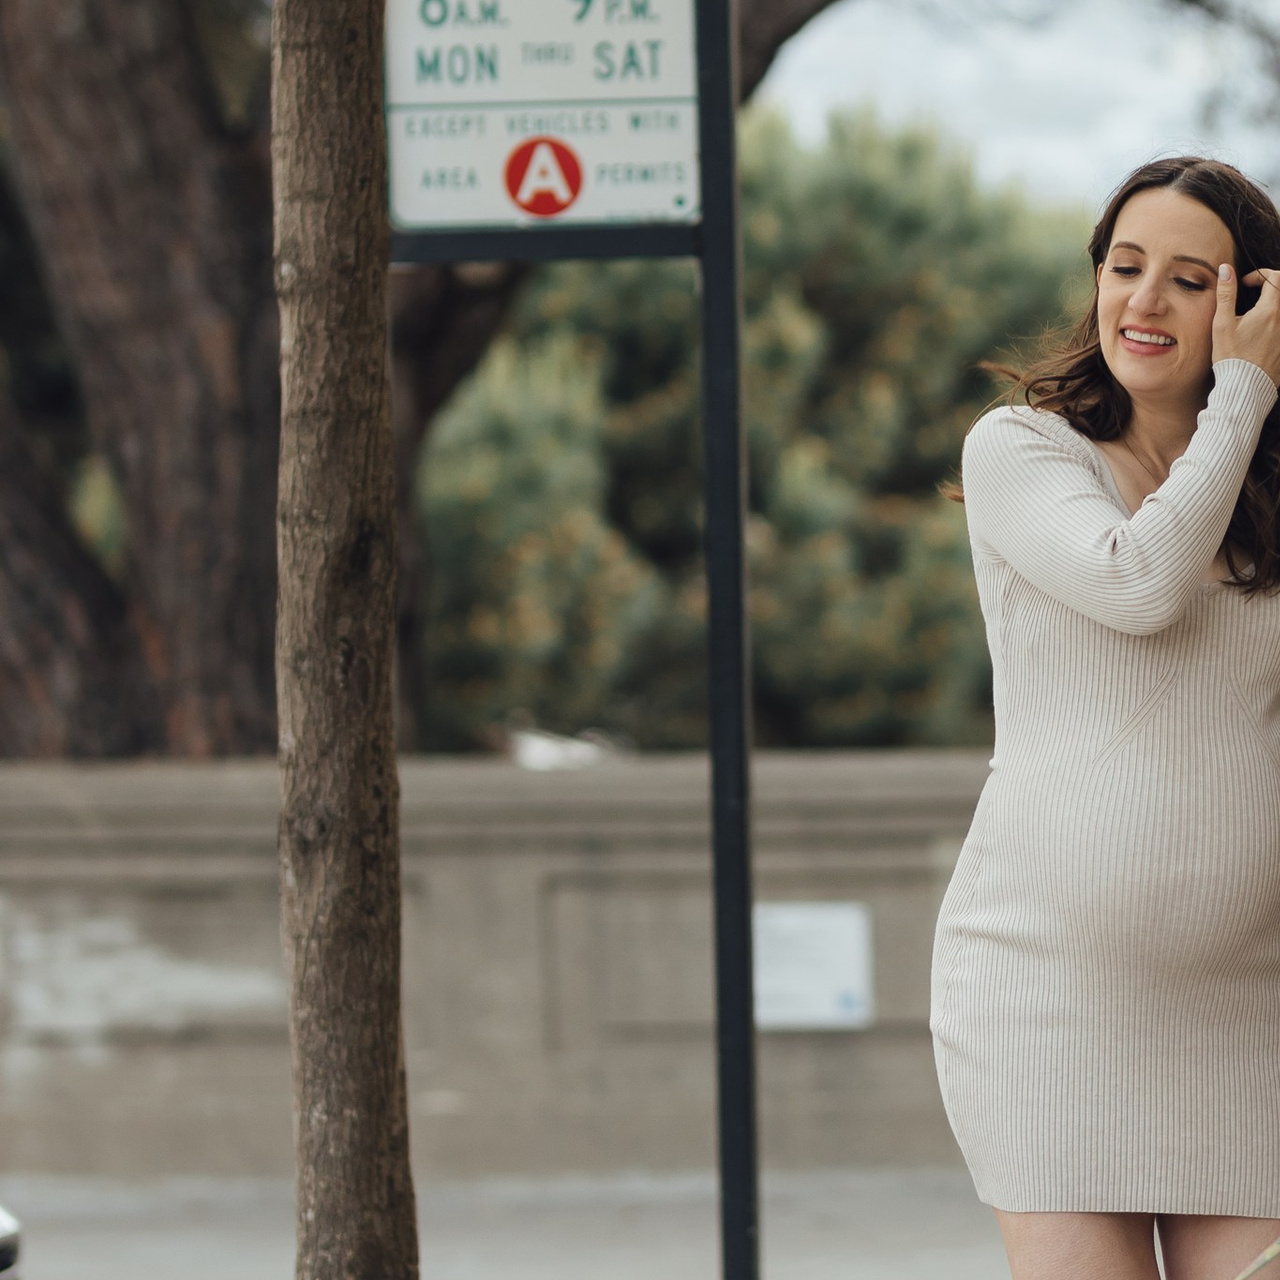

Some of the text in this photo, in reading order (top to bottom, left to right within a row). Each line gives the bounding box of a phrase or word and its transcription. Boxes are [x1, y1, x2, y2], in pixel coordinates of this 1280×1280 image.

[416, 38, 664, 85] MON THRU SAT
[404, 108, 681, 138] EXCEPT VEHICLES WITH
[422, 141, 686, 205] AREA A PERMITS
